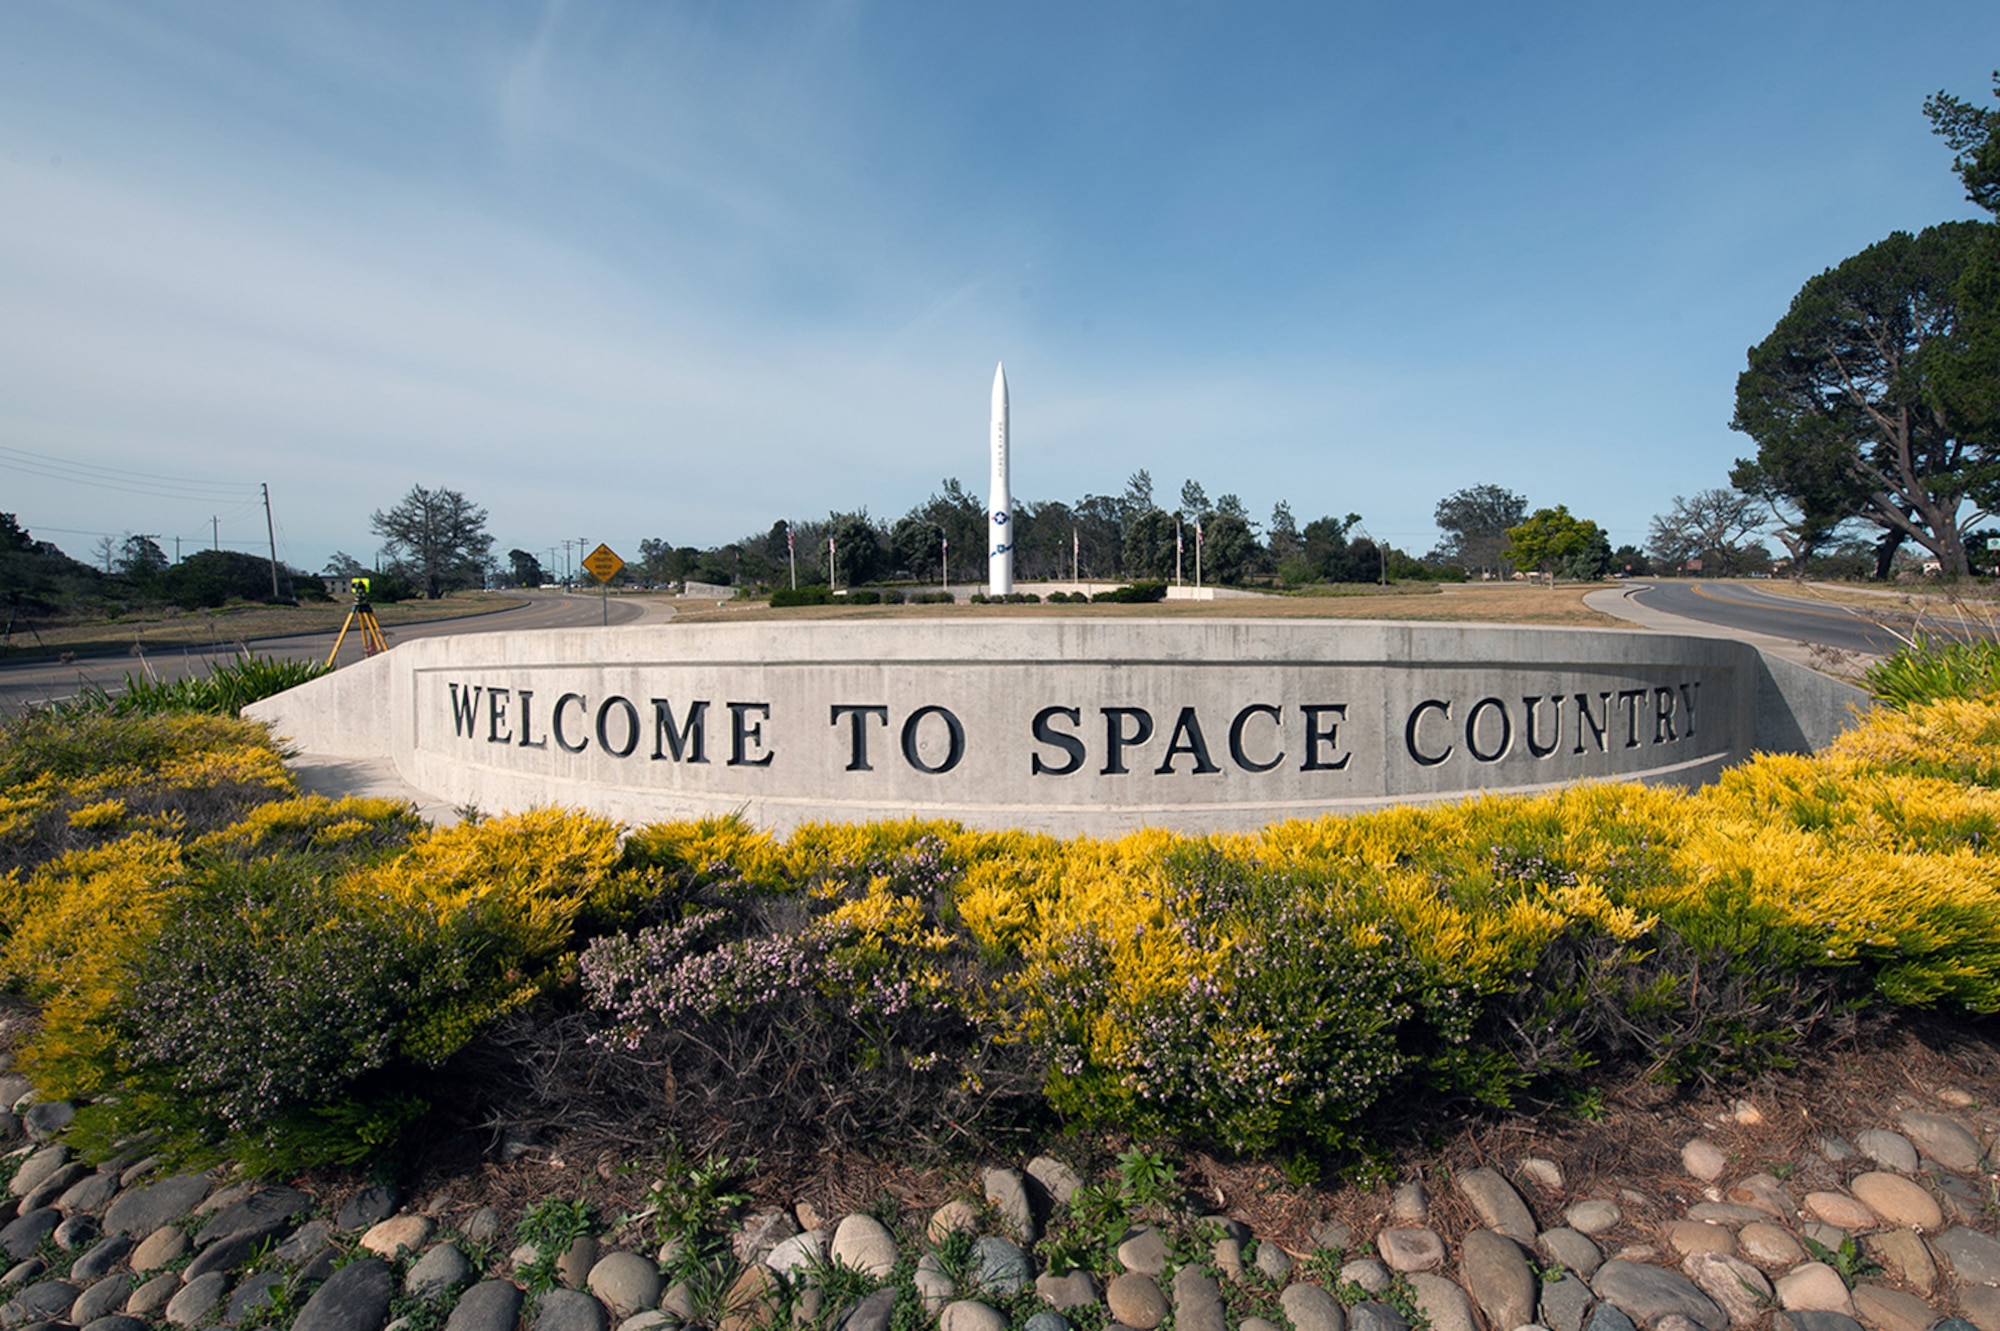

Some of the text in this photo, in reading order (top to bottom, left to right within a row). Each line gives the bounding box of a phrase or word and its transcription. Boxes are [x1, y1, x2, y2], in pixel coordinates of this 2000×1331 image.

[449, 682, 1700, 776] WELCOME TO SPACE COUNTRY
